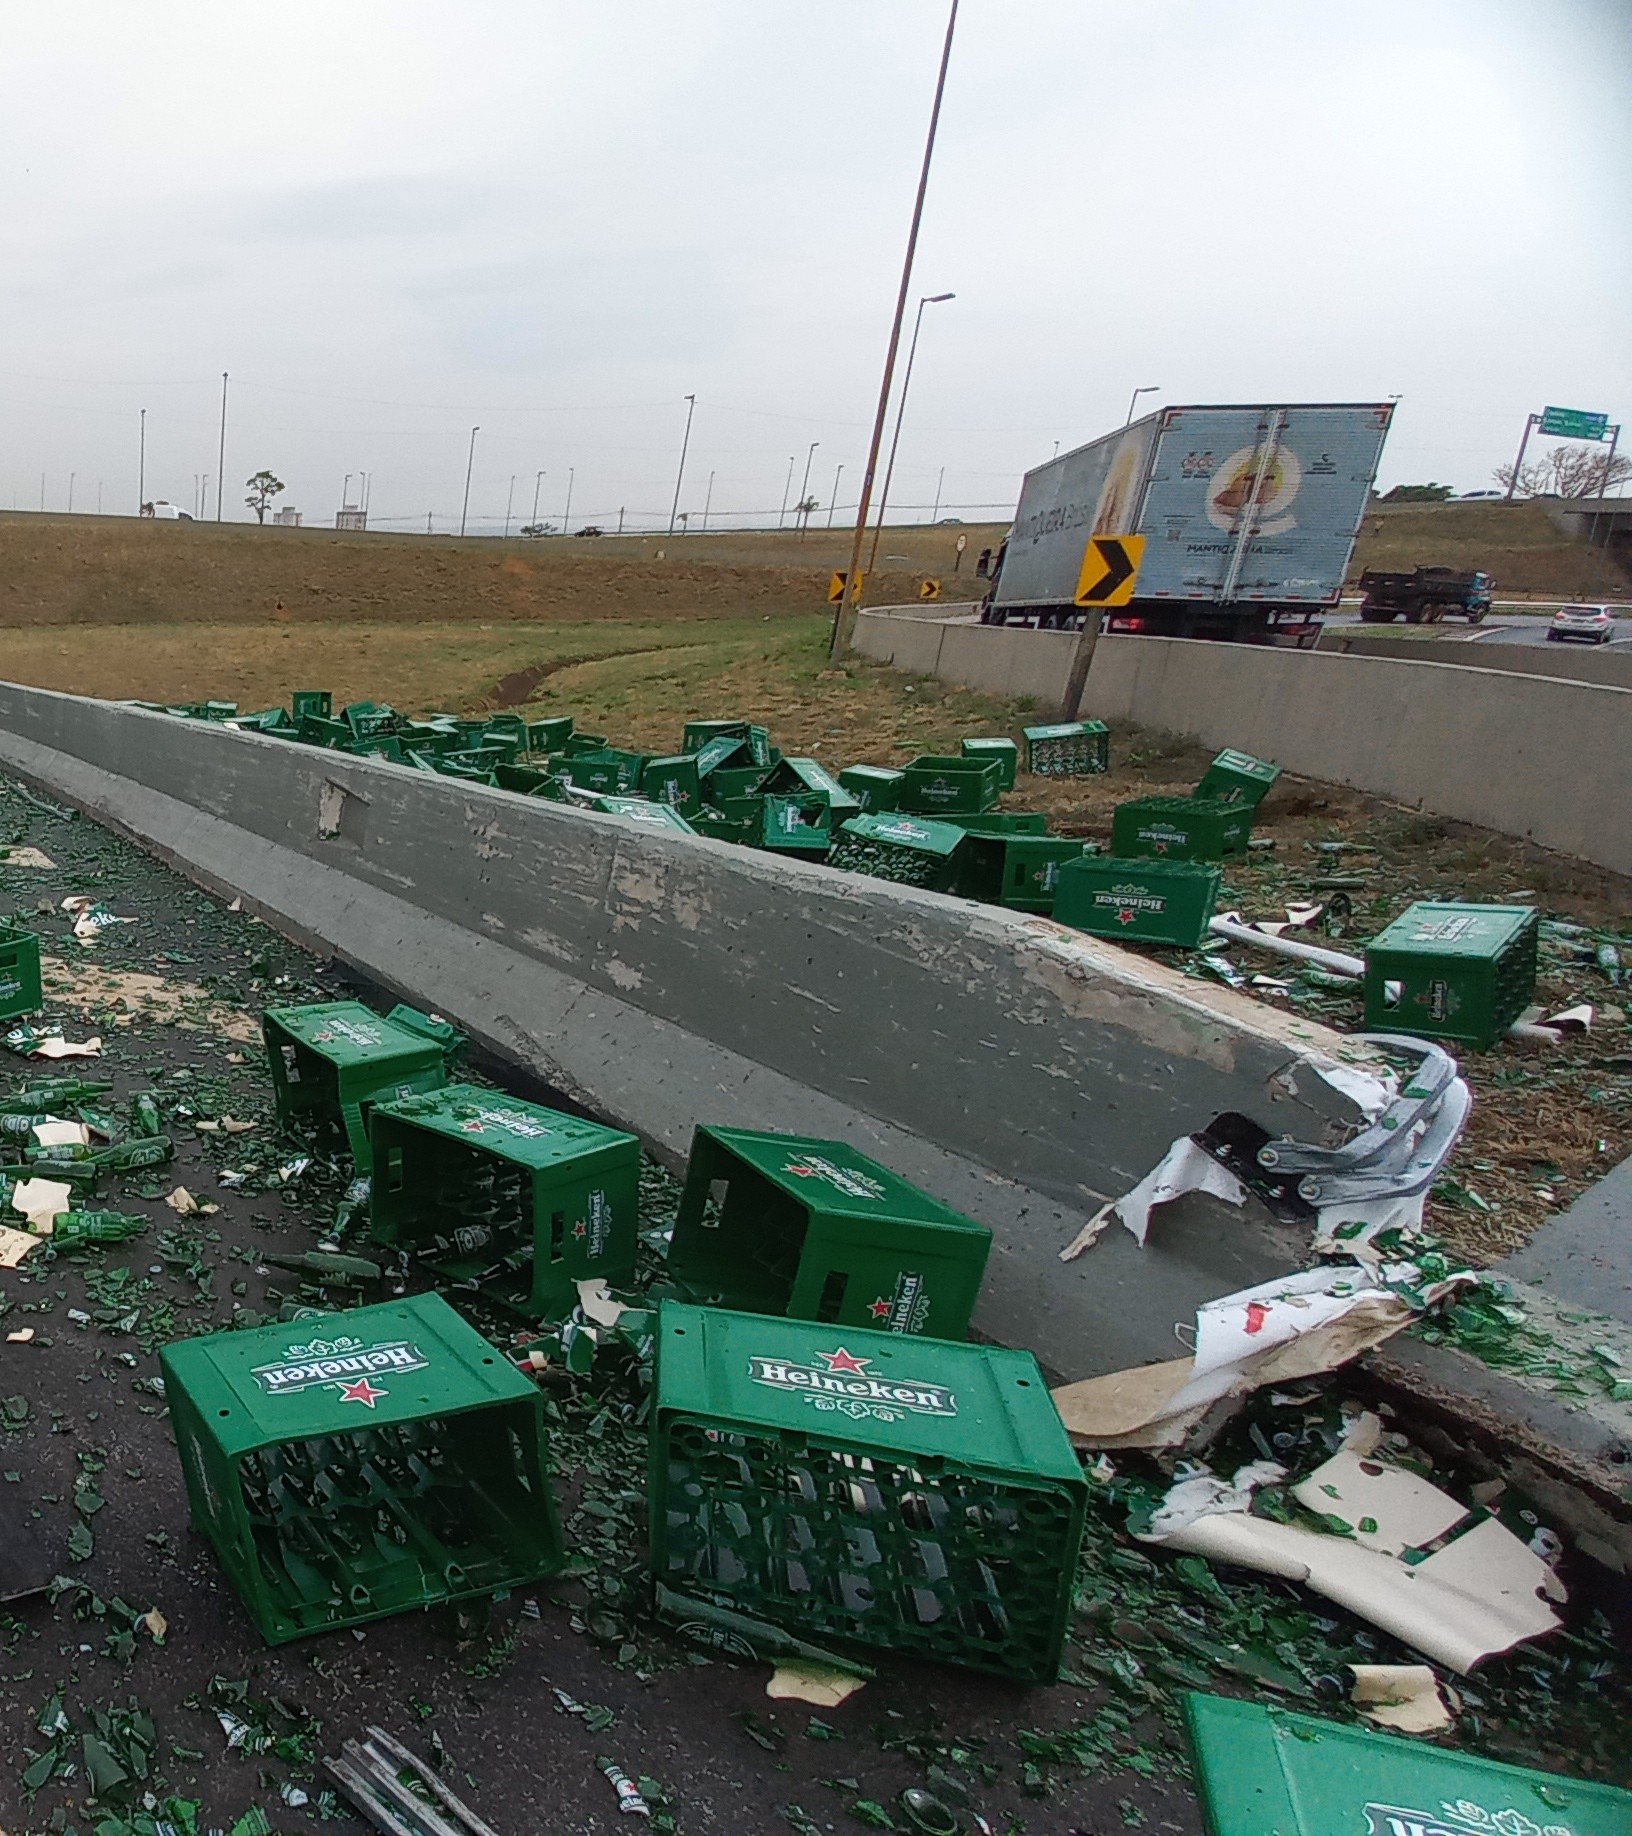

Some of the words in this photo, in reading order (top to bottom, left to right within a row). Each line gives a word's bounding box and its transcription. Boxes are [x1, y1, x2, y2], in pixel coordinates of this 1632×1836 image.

[1095, 895, 1163, 910] Heineken
[588, 1193, 602, 1256] Heineken
[890, 1275, 918, 1335] eineken
[262, 1347, 418, 1386] Heineken
[759, 1361, 945, 1409] Heineken
